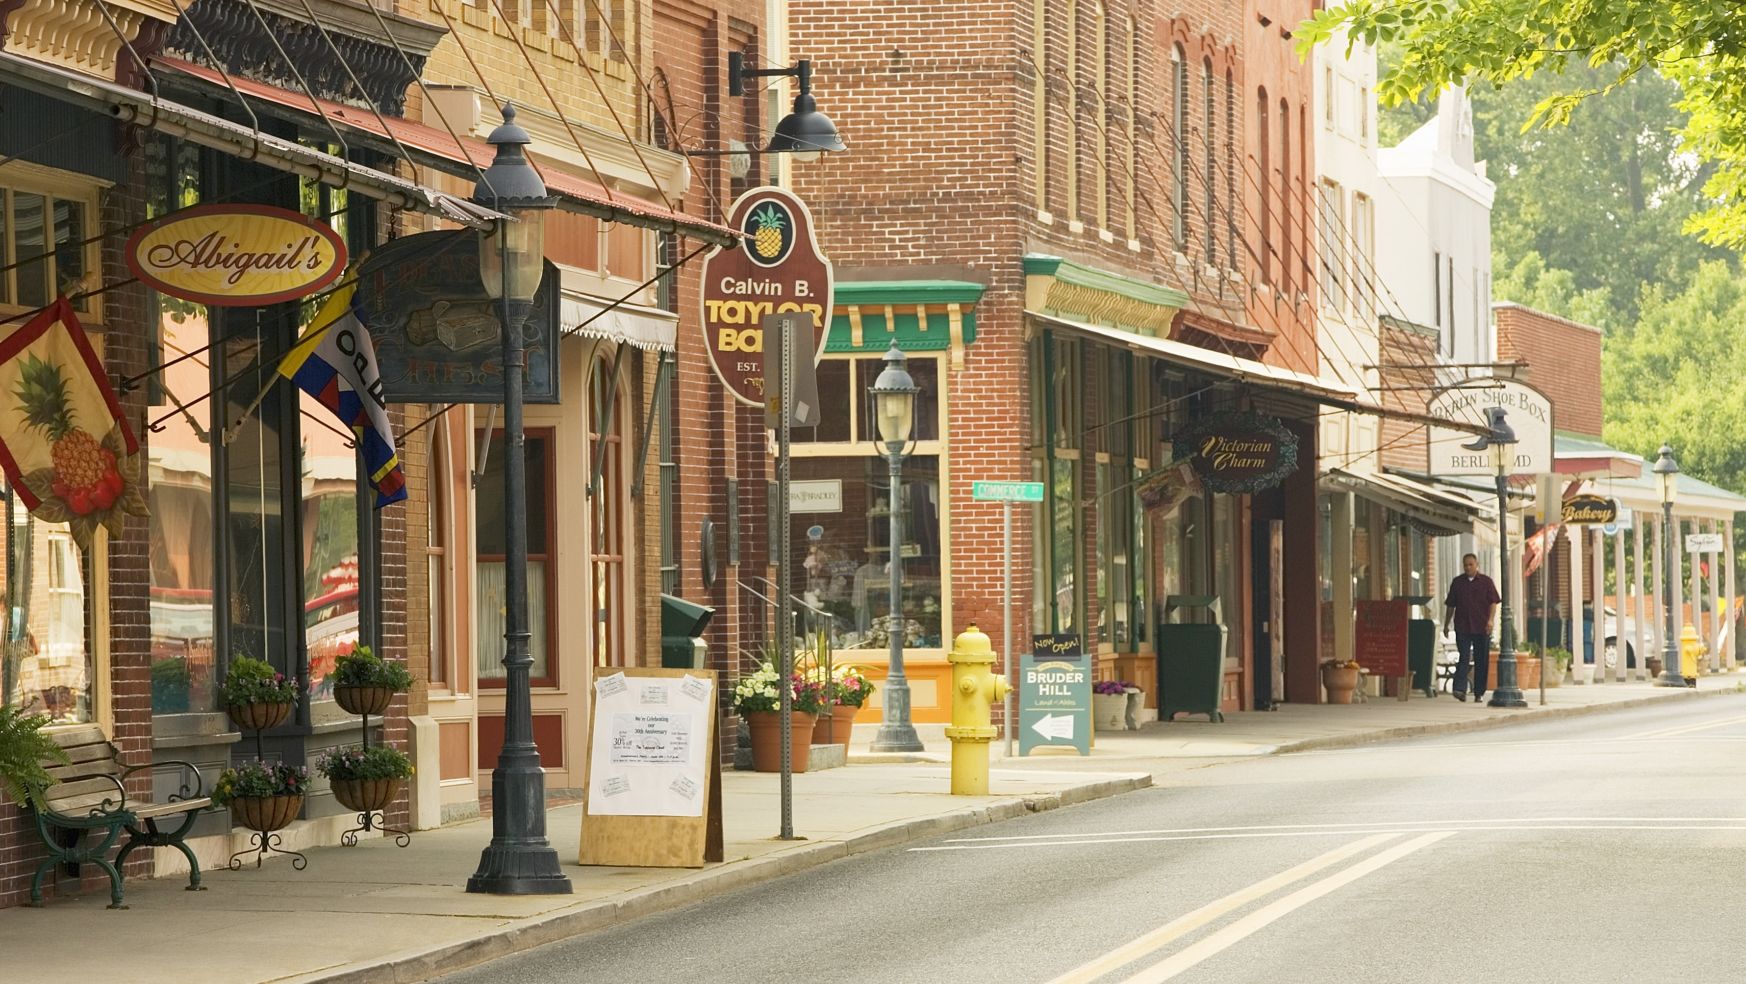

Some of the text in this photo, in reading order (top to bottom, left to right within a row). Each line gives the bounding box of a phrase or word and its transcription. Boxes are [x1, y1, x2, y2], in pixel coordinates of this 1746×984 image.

[148, 230, 322, 285] Abigail's
[720, 276, 815, 298] Calvin B.
[336, 330, 386, 411] OPE
[737, 362, 760, 372] EST.
[1483, 387, 1516, 407] SHOE
[1518, 391, 1548, 424] BOX
[1201, 436, 1271, 458] Victorian
[1212, 452, 1266, 471] Charm
[1451, 455, 1490, 468] BERLI
[978, 483, 1026, 498] COMMERCE
[1562, 505, 1612, 522] Bakery
[1026, 671, 1084, 684] BRUDER
[1039, 684, 1072, 696] HILL
